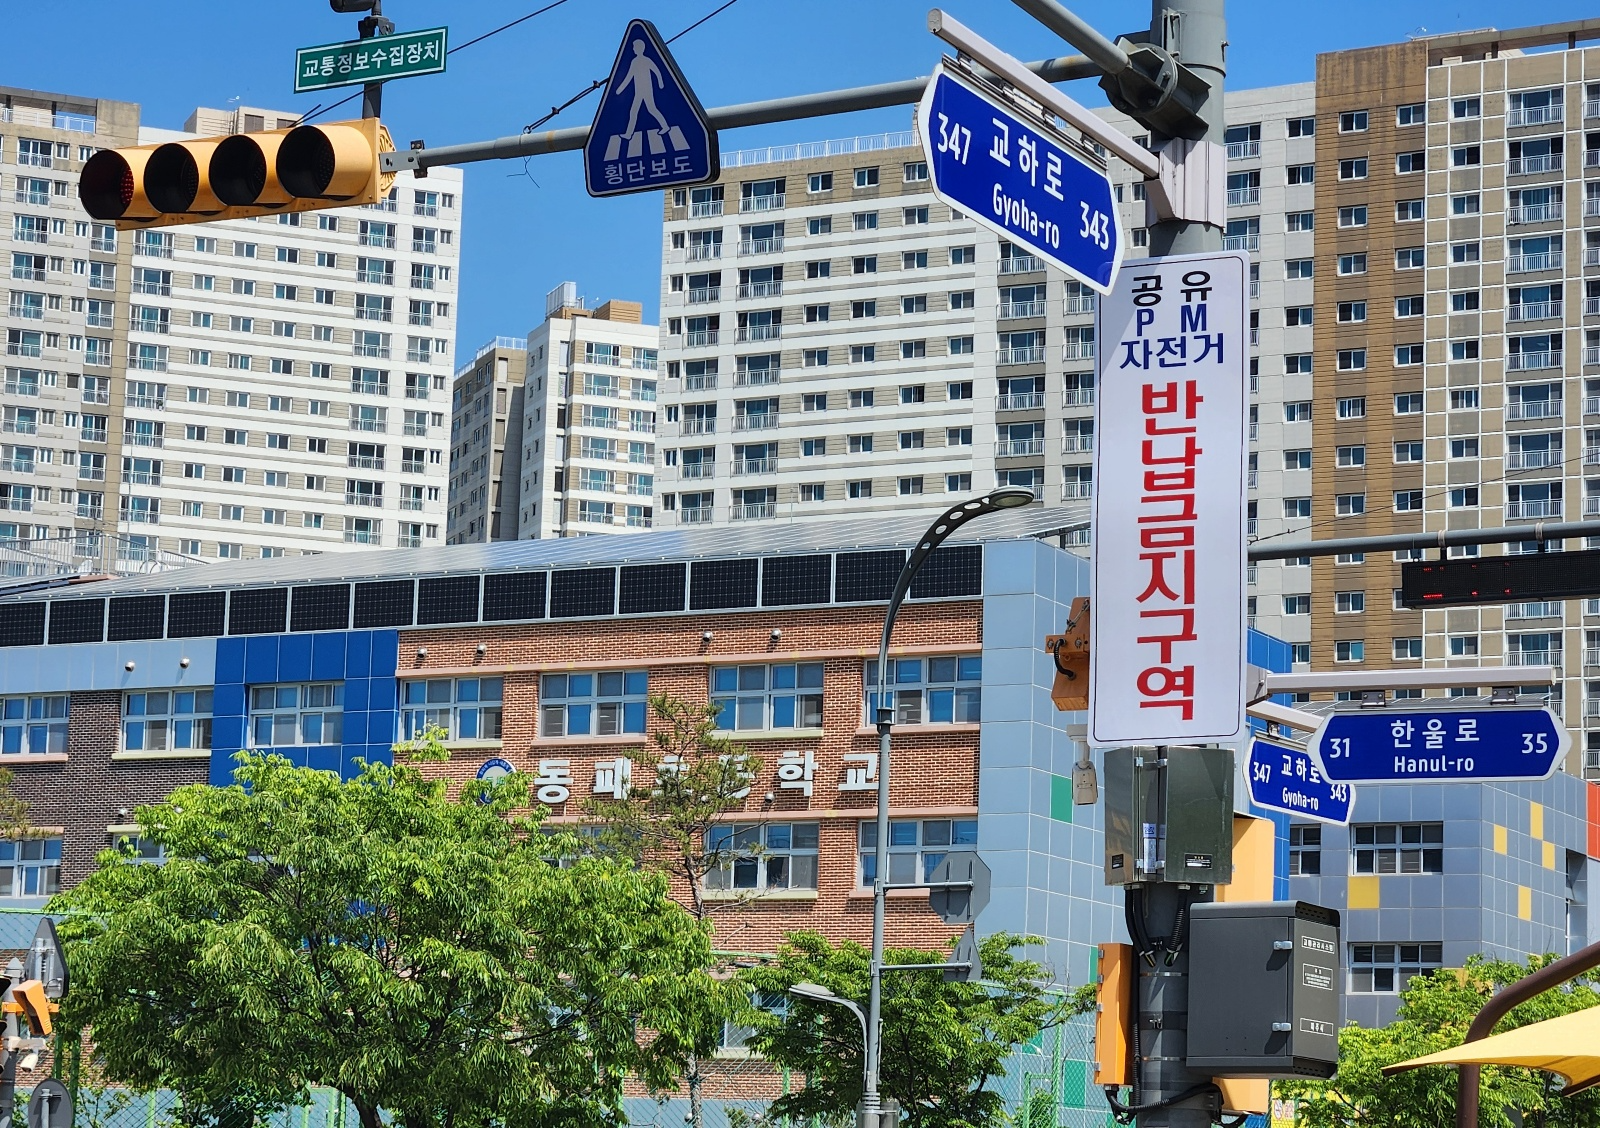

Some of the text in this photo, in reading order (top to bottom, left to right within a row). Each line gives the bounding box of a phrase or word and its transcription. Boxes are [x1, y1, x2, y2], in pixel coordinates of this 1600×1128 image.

[302, 39, 439, 77] 교통정보수집장치
[937, 112, 972, 165] 347
[604, 155, 693, 185] 횡단보도
[989, 118, 1064, 201] 교하로
[992, 183, 1060, 249] Gyoha-ro
[1079, 201, 1109, 250] 343
[1119, 332, 1224, 370] 자전거
[1135, 379, 1204, 721] 반납금지구역
[1329, 738, 1351, 758] 31
[1390, 718, 1480, 750] 한울로
[1521, 733, 1548, 755] 35
[1253, 761, 1272, 784] 347
[1281, 754, 1321, 784] 교하로
[1393, 755, 1474, 773] Hanul-ro
[1282, 786, 1319, 811] Gyoha-ro
[1330, 784, 1347, 803] 343
